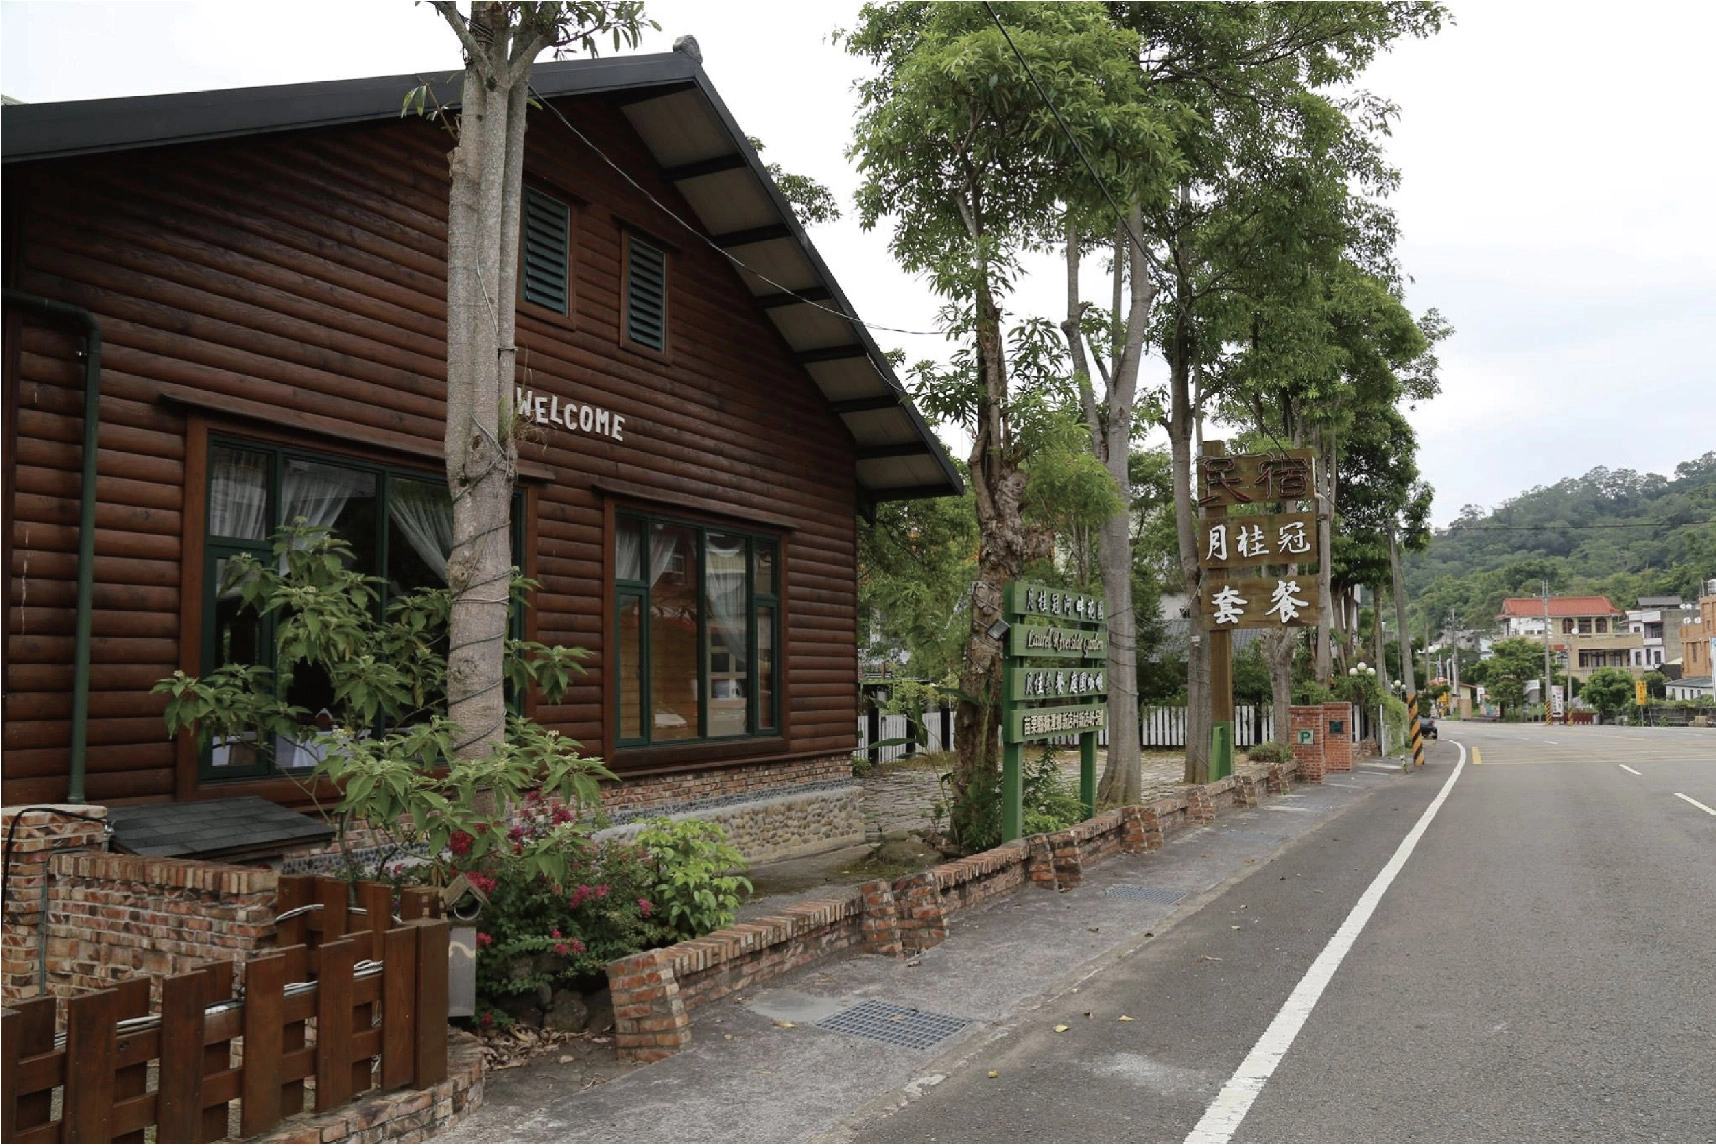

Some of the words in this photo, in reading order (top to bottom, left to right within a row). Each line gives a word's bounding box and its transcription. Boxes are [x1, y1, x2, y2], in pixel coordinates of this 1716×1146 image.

[516, 386, 626, 442] WELCOME
[1197, 457, 1310, 506] 民宿
[1206, 521, 1312, 562] 月桂冠
[1211, 580, 1310, 625] 套餐
